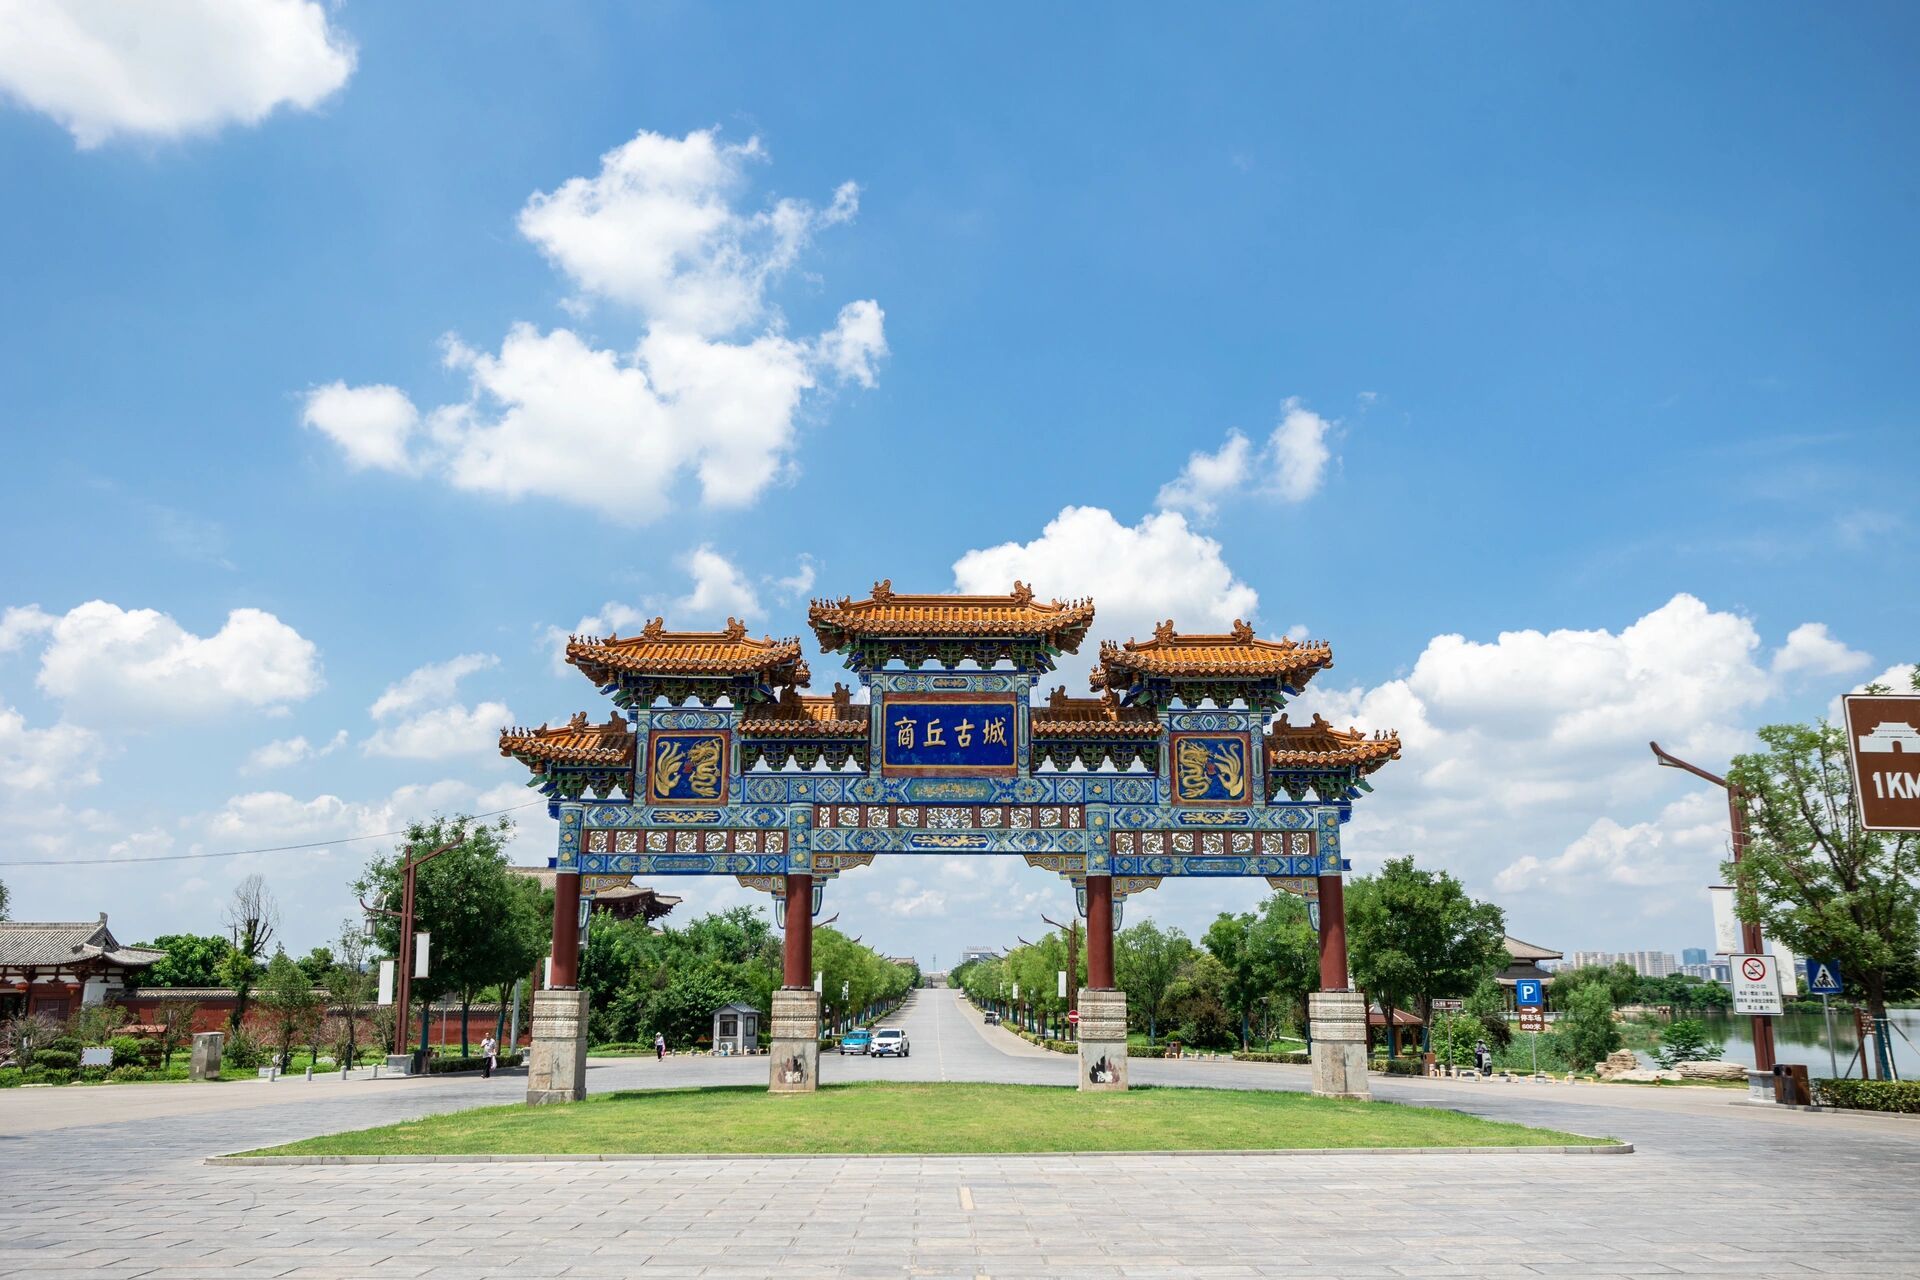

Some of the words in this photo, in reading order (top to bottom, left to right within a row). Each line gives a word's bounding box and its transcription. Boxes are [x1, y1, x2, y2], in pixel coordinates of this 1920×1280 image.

[894, 716, 1008, 749] 商丘古城
[1523, 986, 1534, 1000] P
[1520, 1014, 1542, 1022] 停车场
